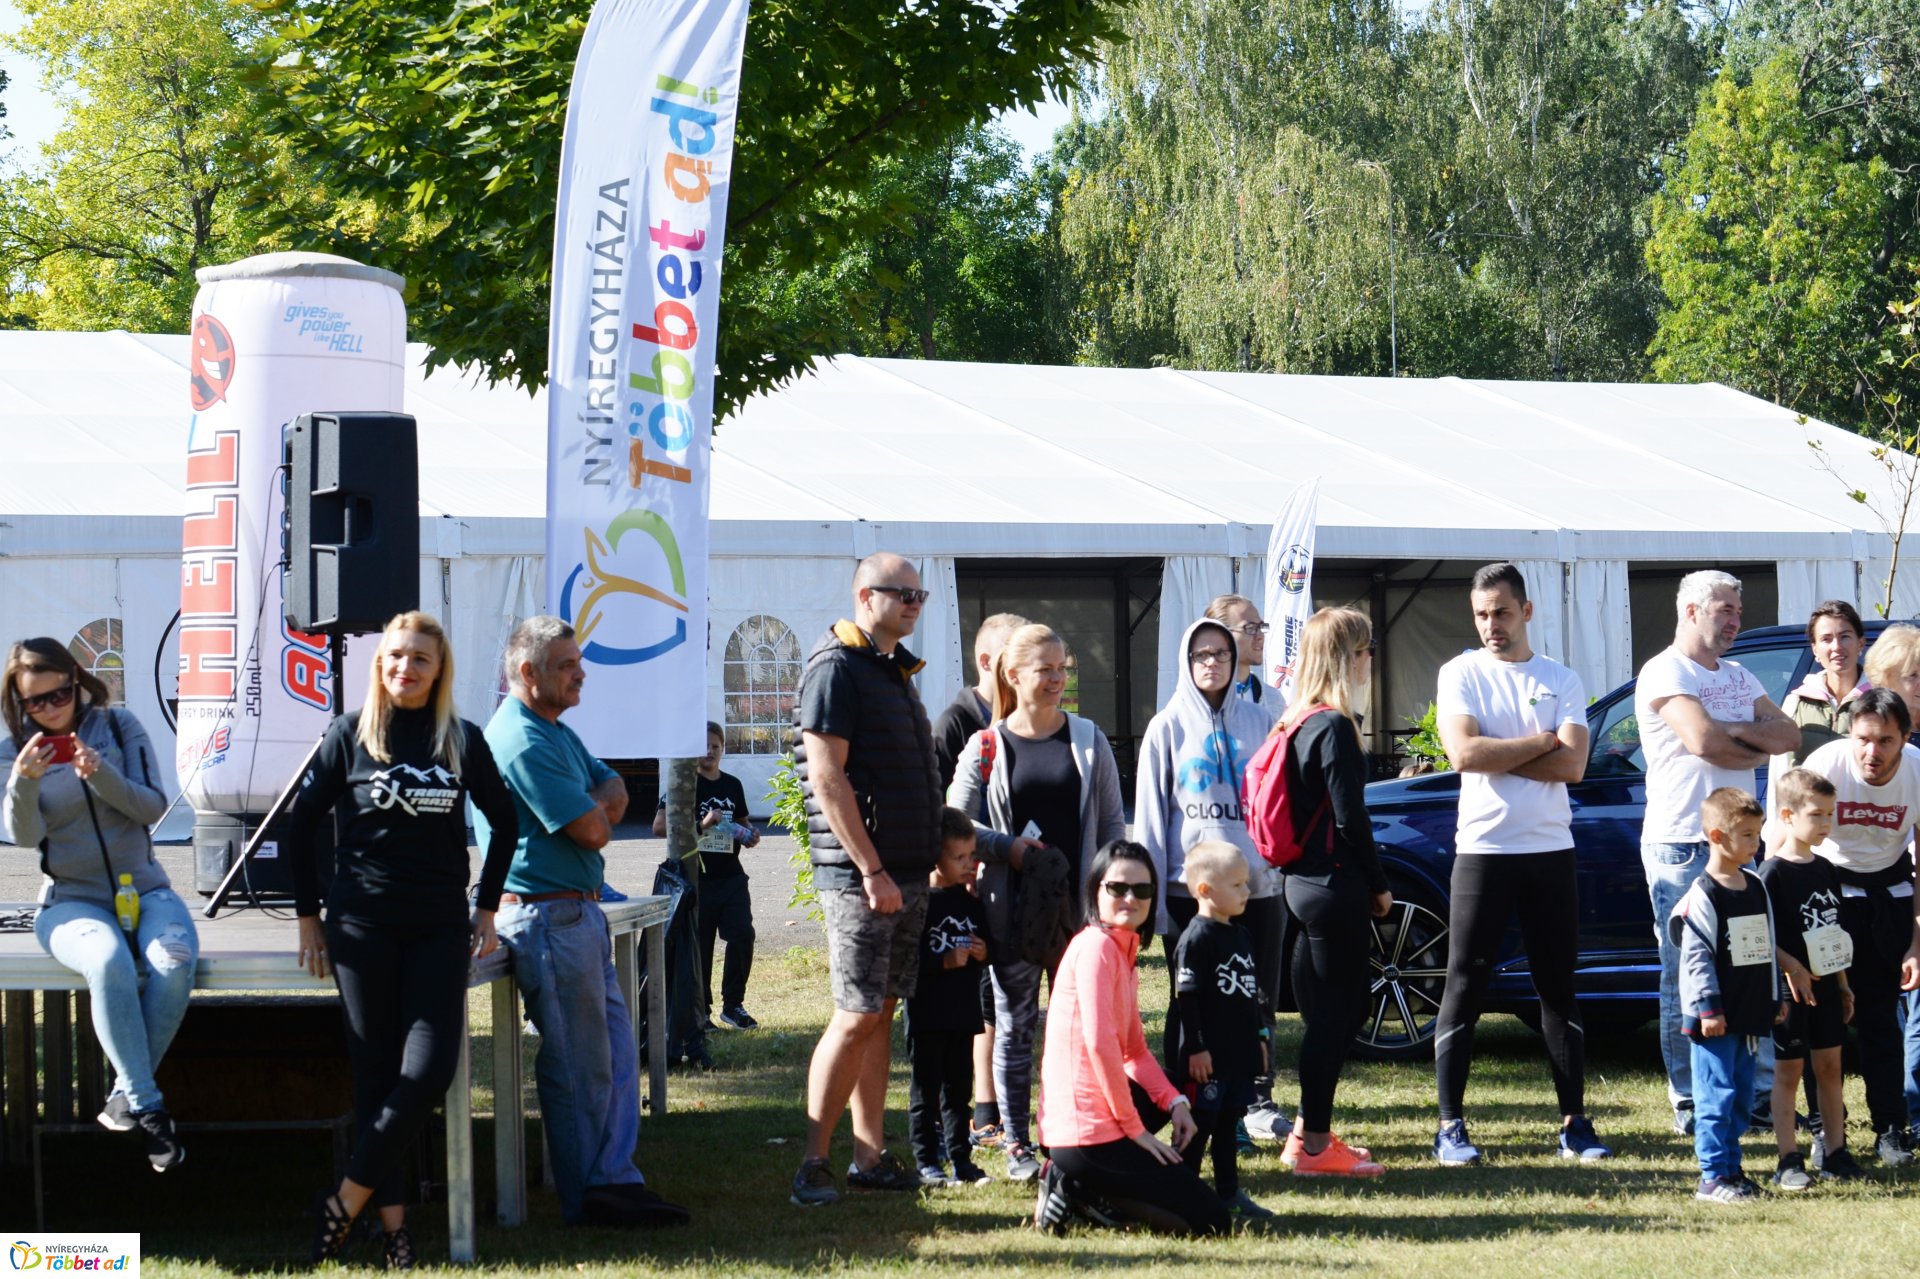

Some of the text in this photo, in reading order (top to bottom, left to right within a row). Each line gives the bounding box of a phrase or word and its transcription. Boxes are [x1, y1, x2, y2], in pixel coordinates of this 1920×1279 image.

[627, 73, 719, 490] Többet ad!
[284, 301, 328, 322] gives
[299, 319, 351, 336] power
[577, 177, 631, 487] NYÍREGYHÁZA
[328, 333, 363, 352] HELL
[176, 430, 240, 703] HELL
[200, 706, 235, 719] DRINK
[1186, 802, 1245, 821] CLOU
